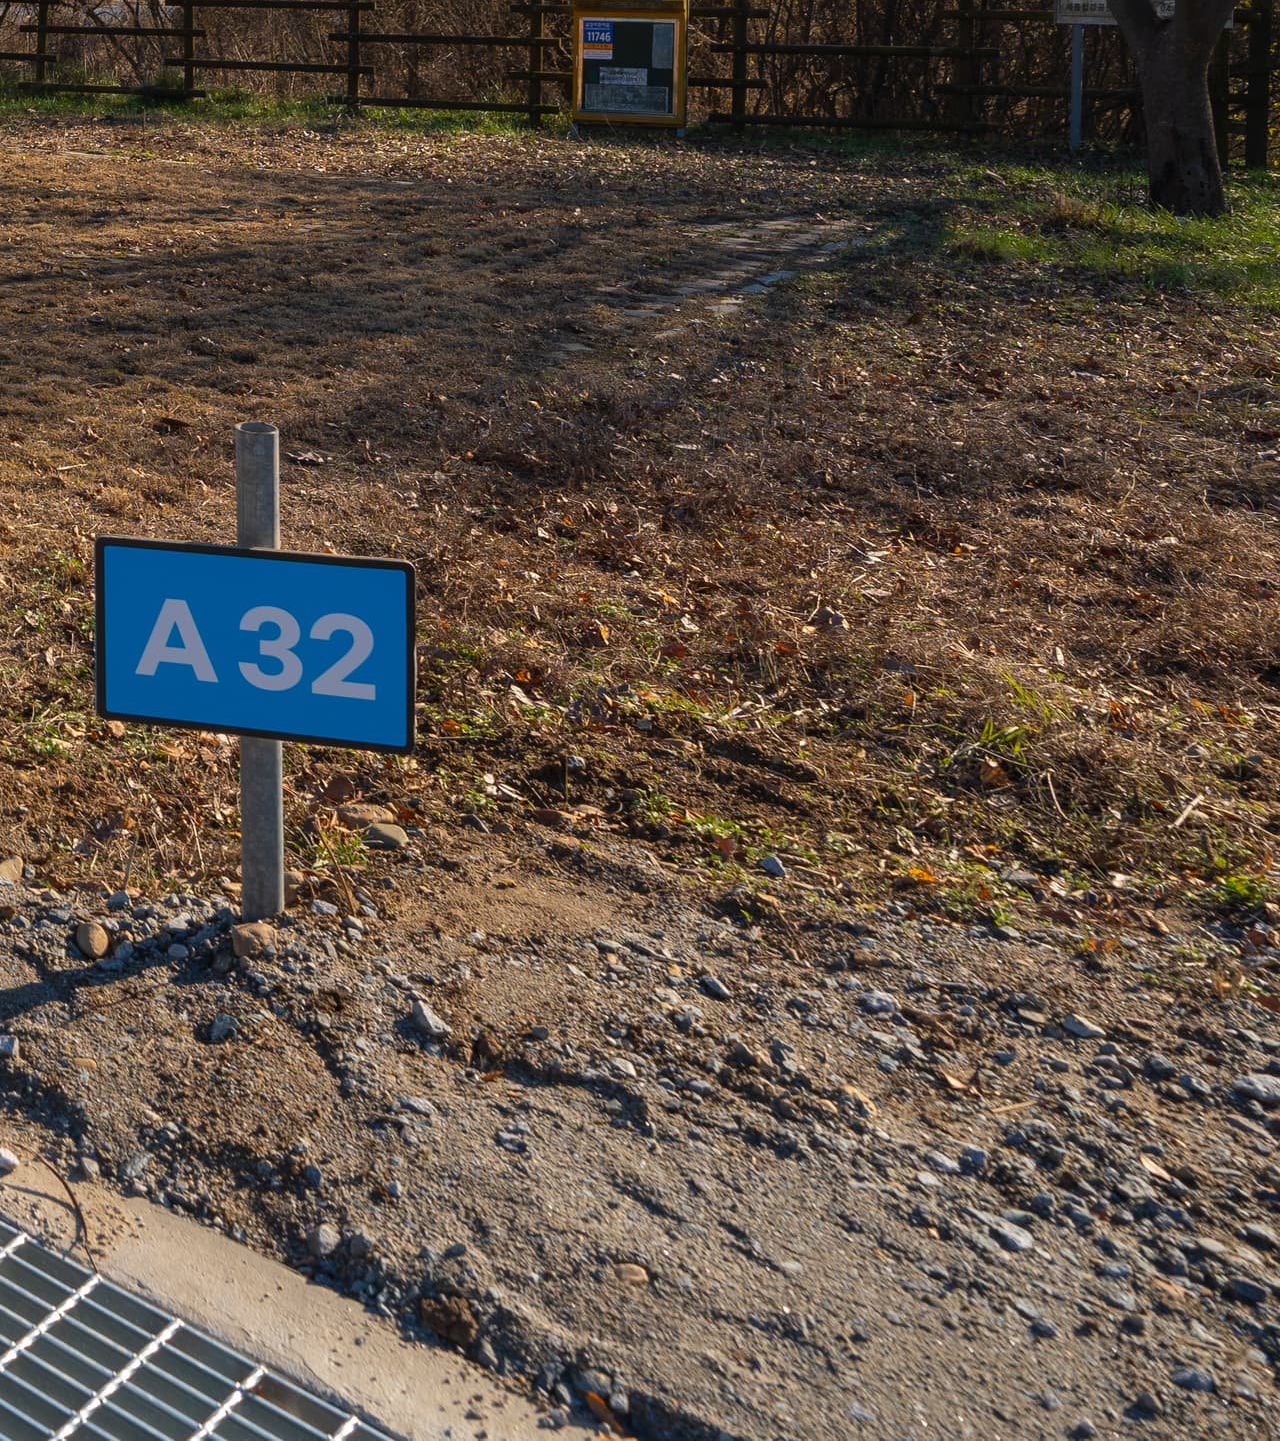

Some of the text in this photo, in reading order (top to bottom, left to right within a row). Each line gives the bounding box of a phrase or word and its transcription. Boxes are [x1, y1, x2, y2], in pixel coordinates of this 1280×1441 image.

[587, 31, 611, 43] 11746
[135, 598, 376, 701] A 32
